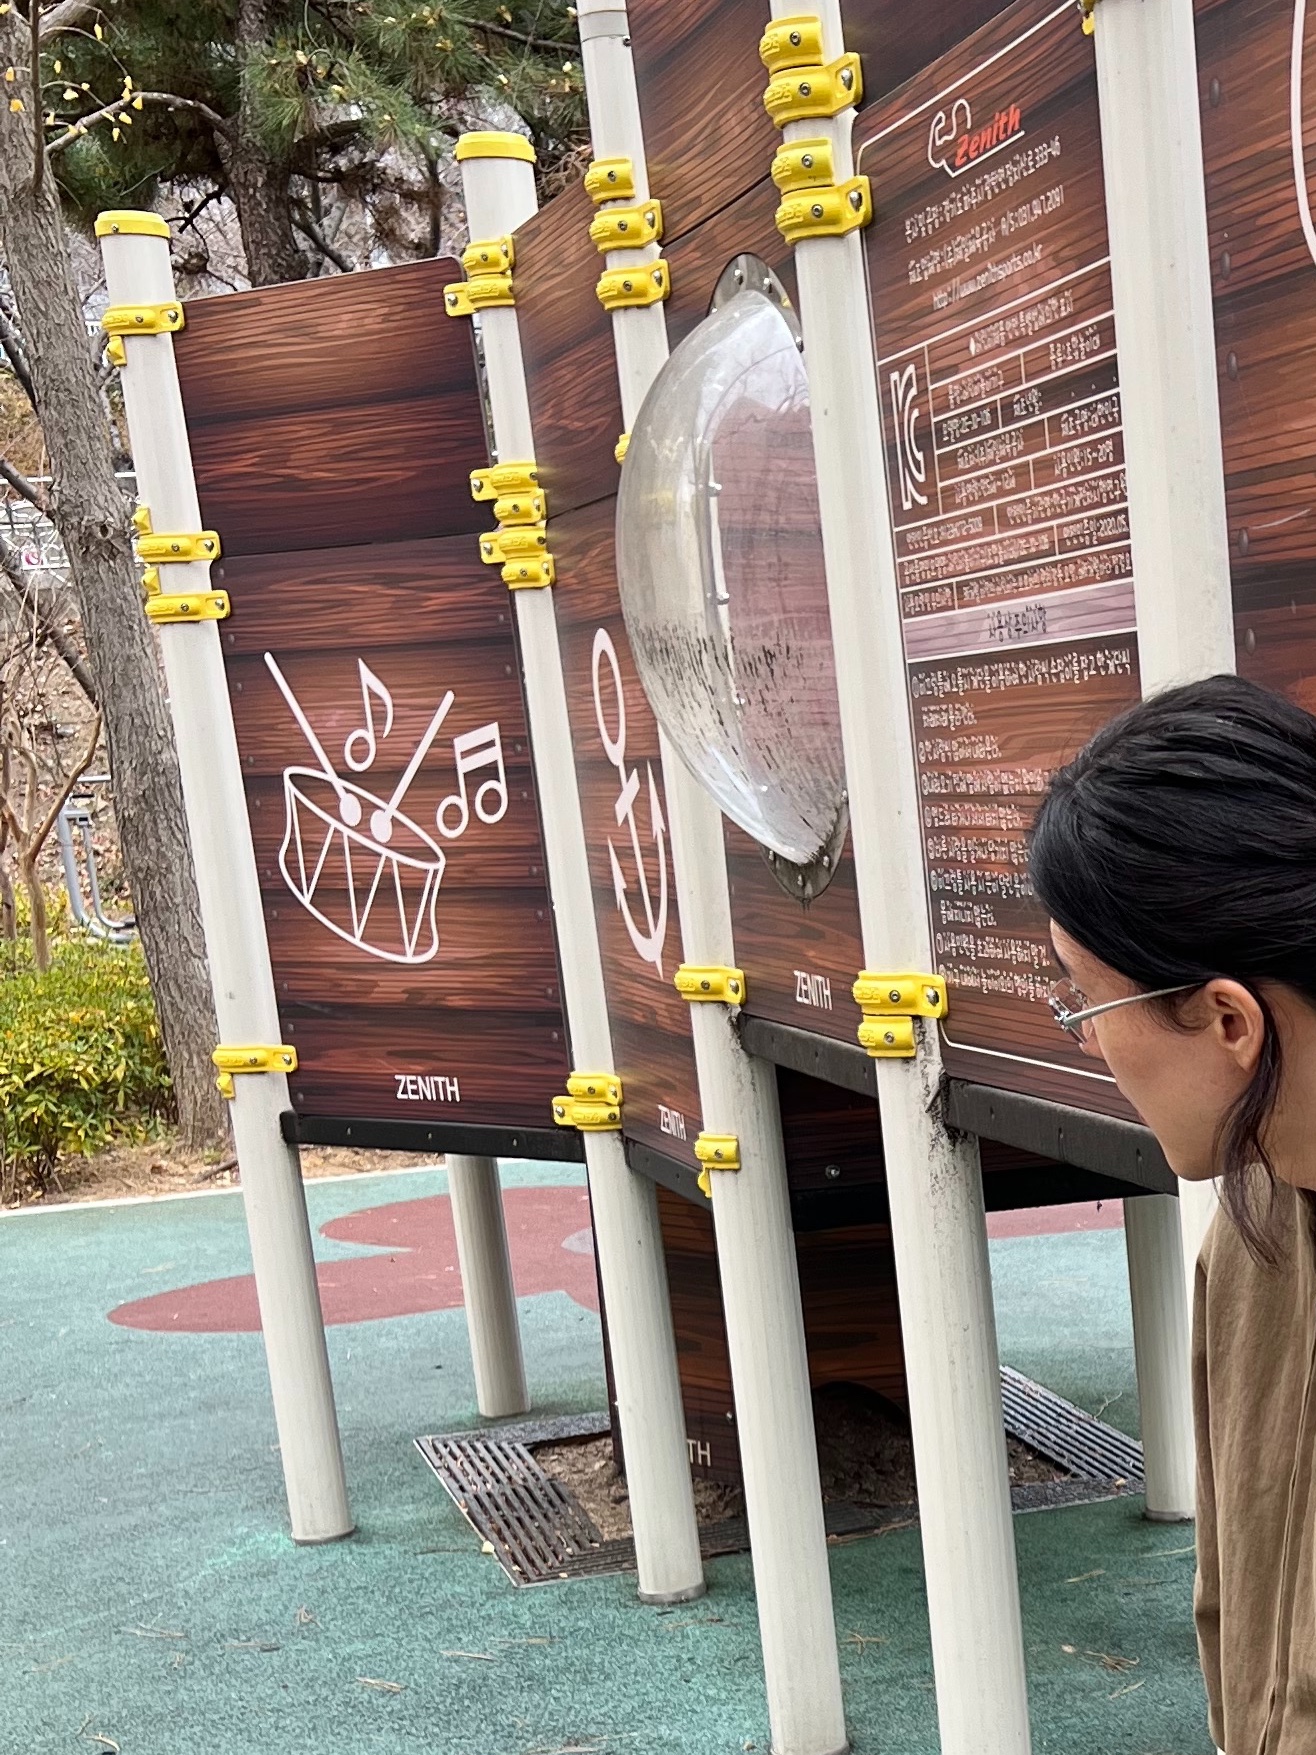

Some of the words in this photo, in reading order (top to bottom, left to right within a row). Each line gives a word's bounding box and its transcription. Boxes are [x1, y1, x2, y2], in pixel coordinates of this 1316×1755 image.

[955, 104, 1021, 167] Zenith
[793, 969, 833, 1011] ZENITH
[394, 1074, 461, 1103] ZENITH
